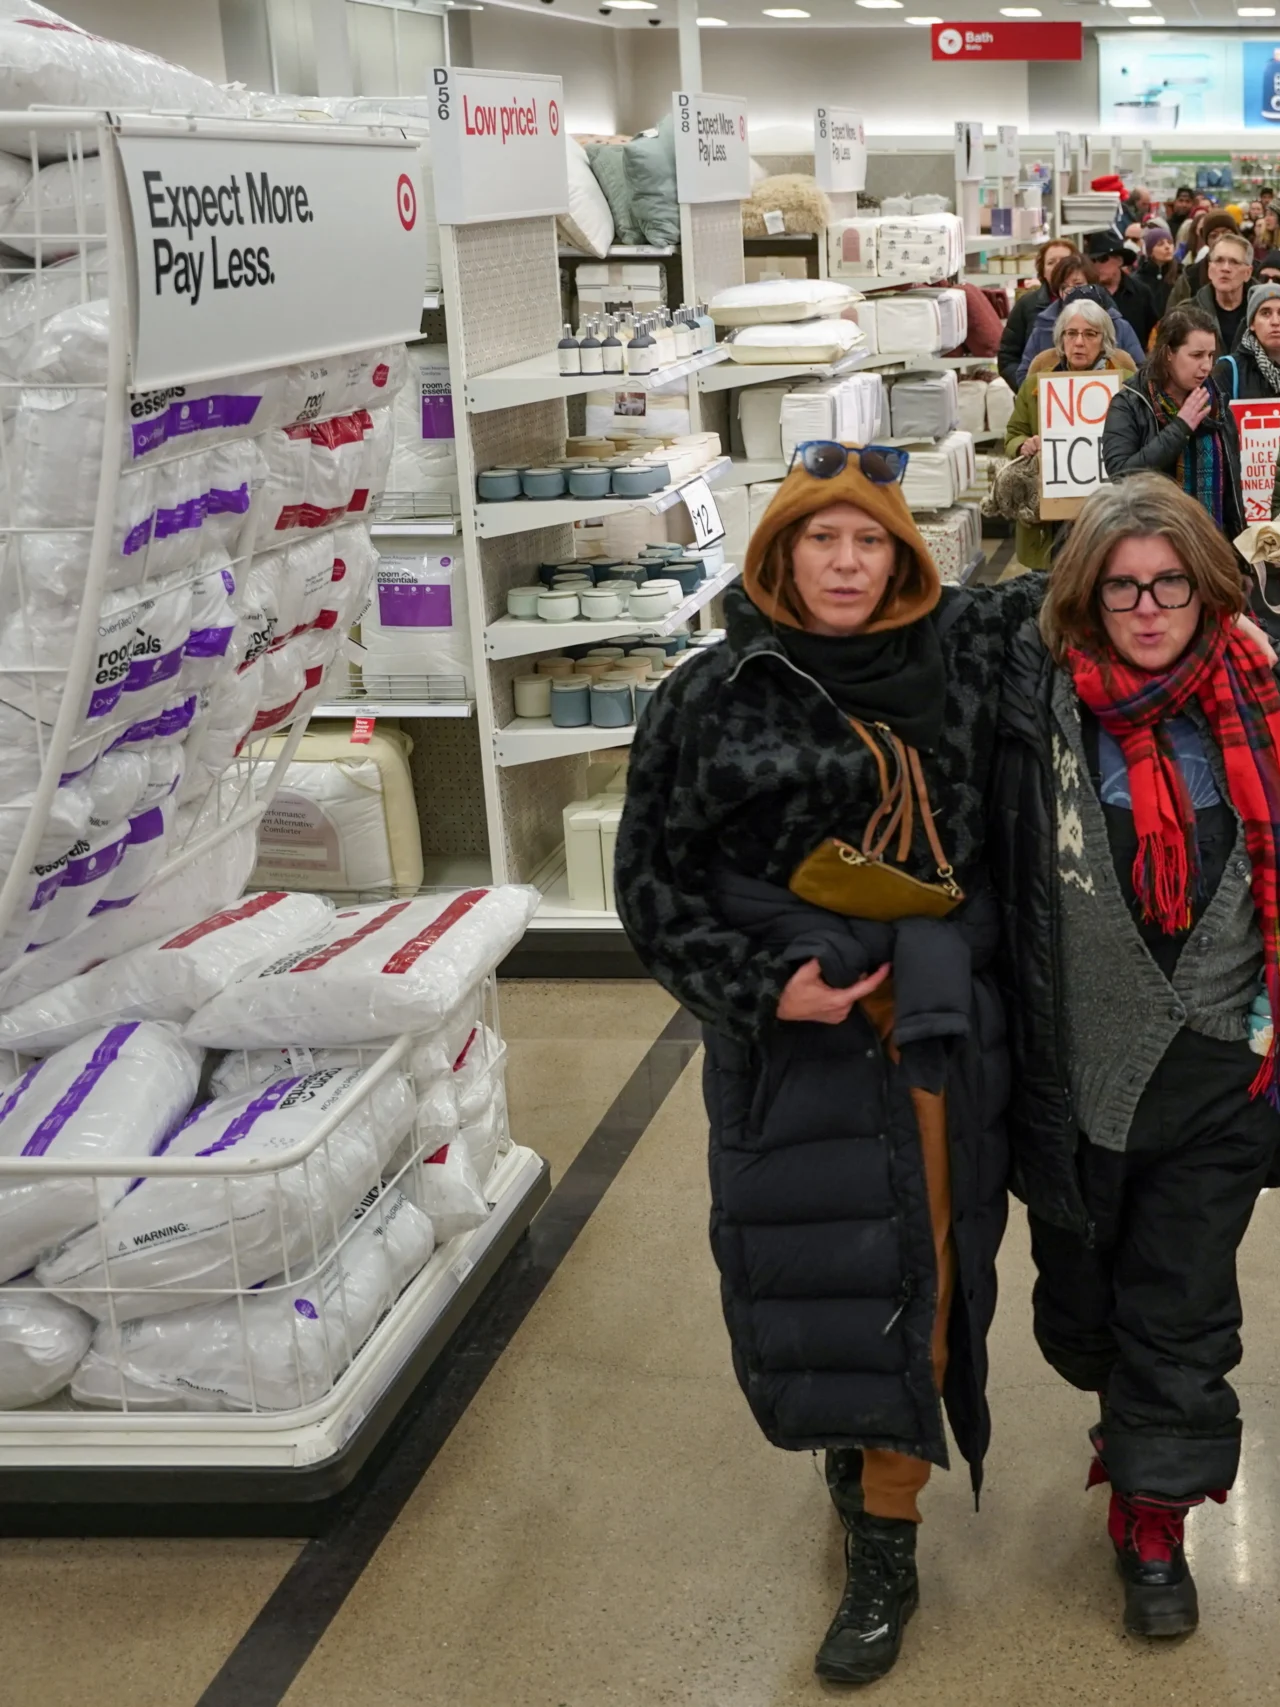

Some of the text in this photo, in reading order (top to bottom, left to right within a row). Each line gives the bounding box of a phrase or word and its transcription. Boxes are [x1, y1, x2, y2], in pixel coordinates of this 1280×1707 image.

[965, 32, 993, 43] Bath
[463, 94, 538, 145] Low price!
[697, 111, 719, 140] Expect
[698, 138, 711, 166] Pay
[142, 170, 313, 240] Expect More.
[153, 236, 275, 305] Pay Less.
[1046, 378, 1113, 429] NO
[1246, 465, 1266, 477] OUT
[692, 504, 713, 537] $12
[377, 576, 418, 584] essentials
[262, 810, 306, 819] erformance
[274, 817, 315, 829] Alternative
[263, 825, 302, 835] Comforter
[132, 1222, 190, 1246] WARNING:
